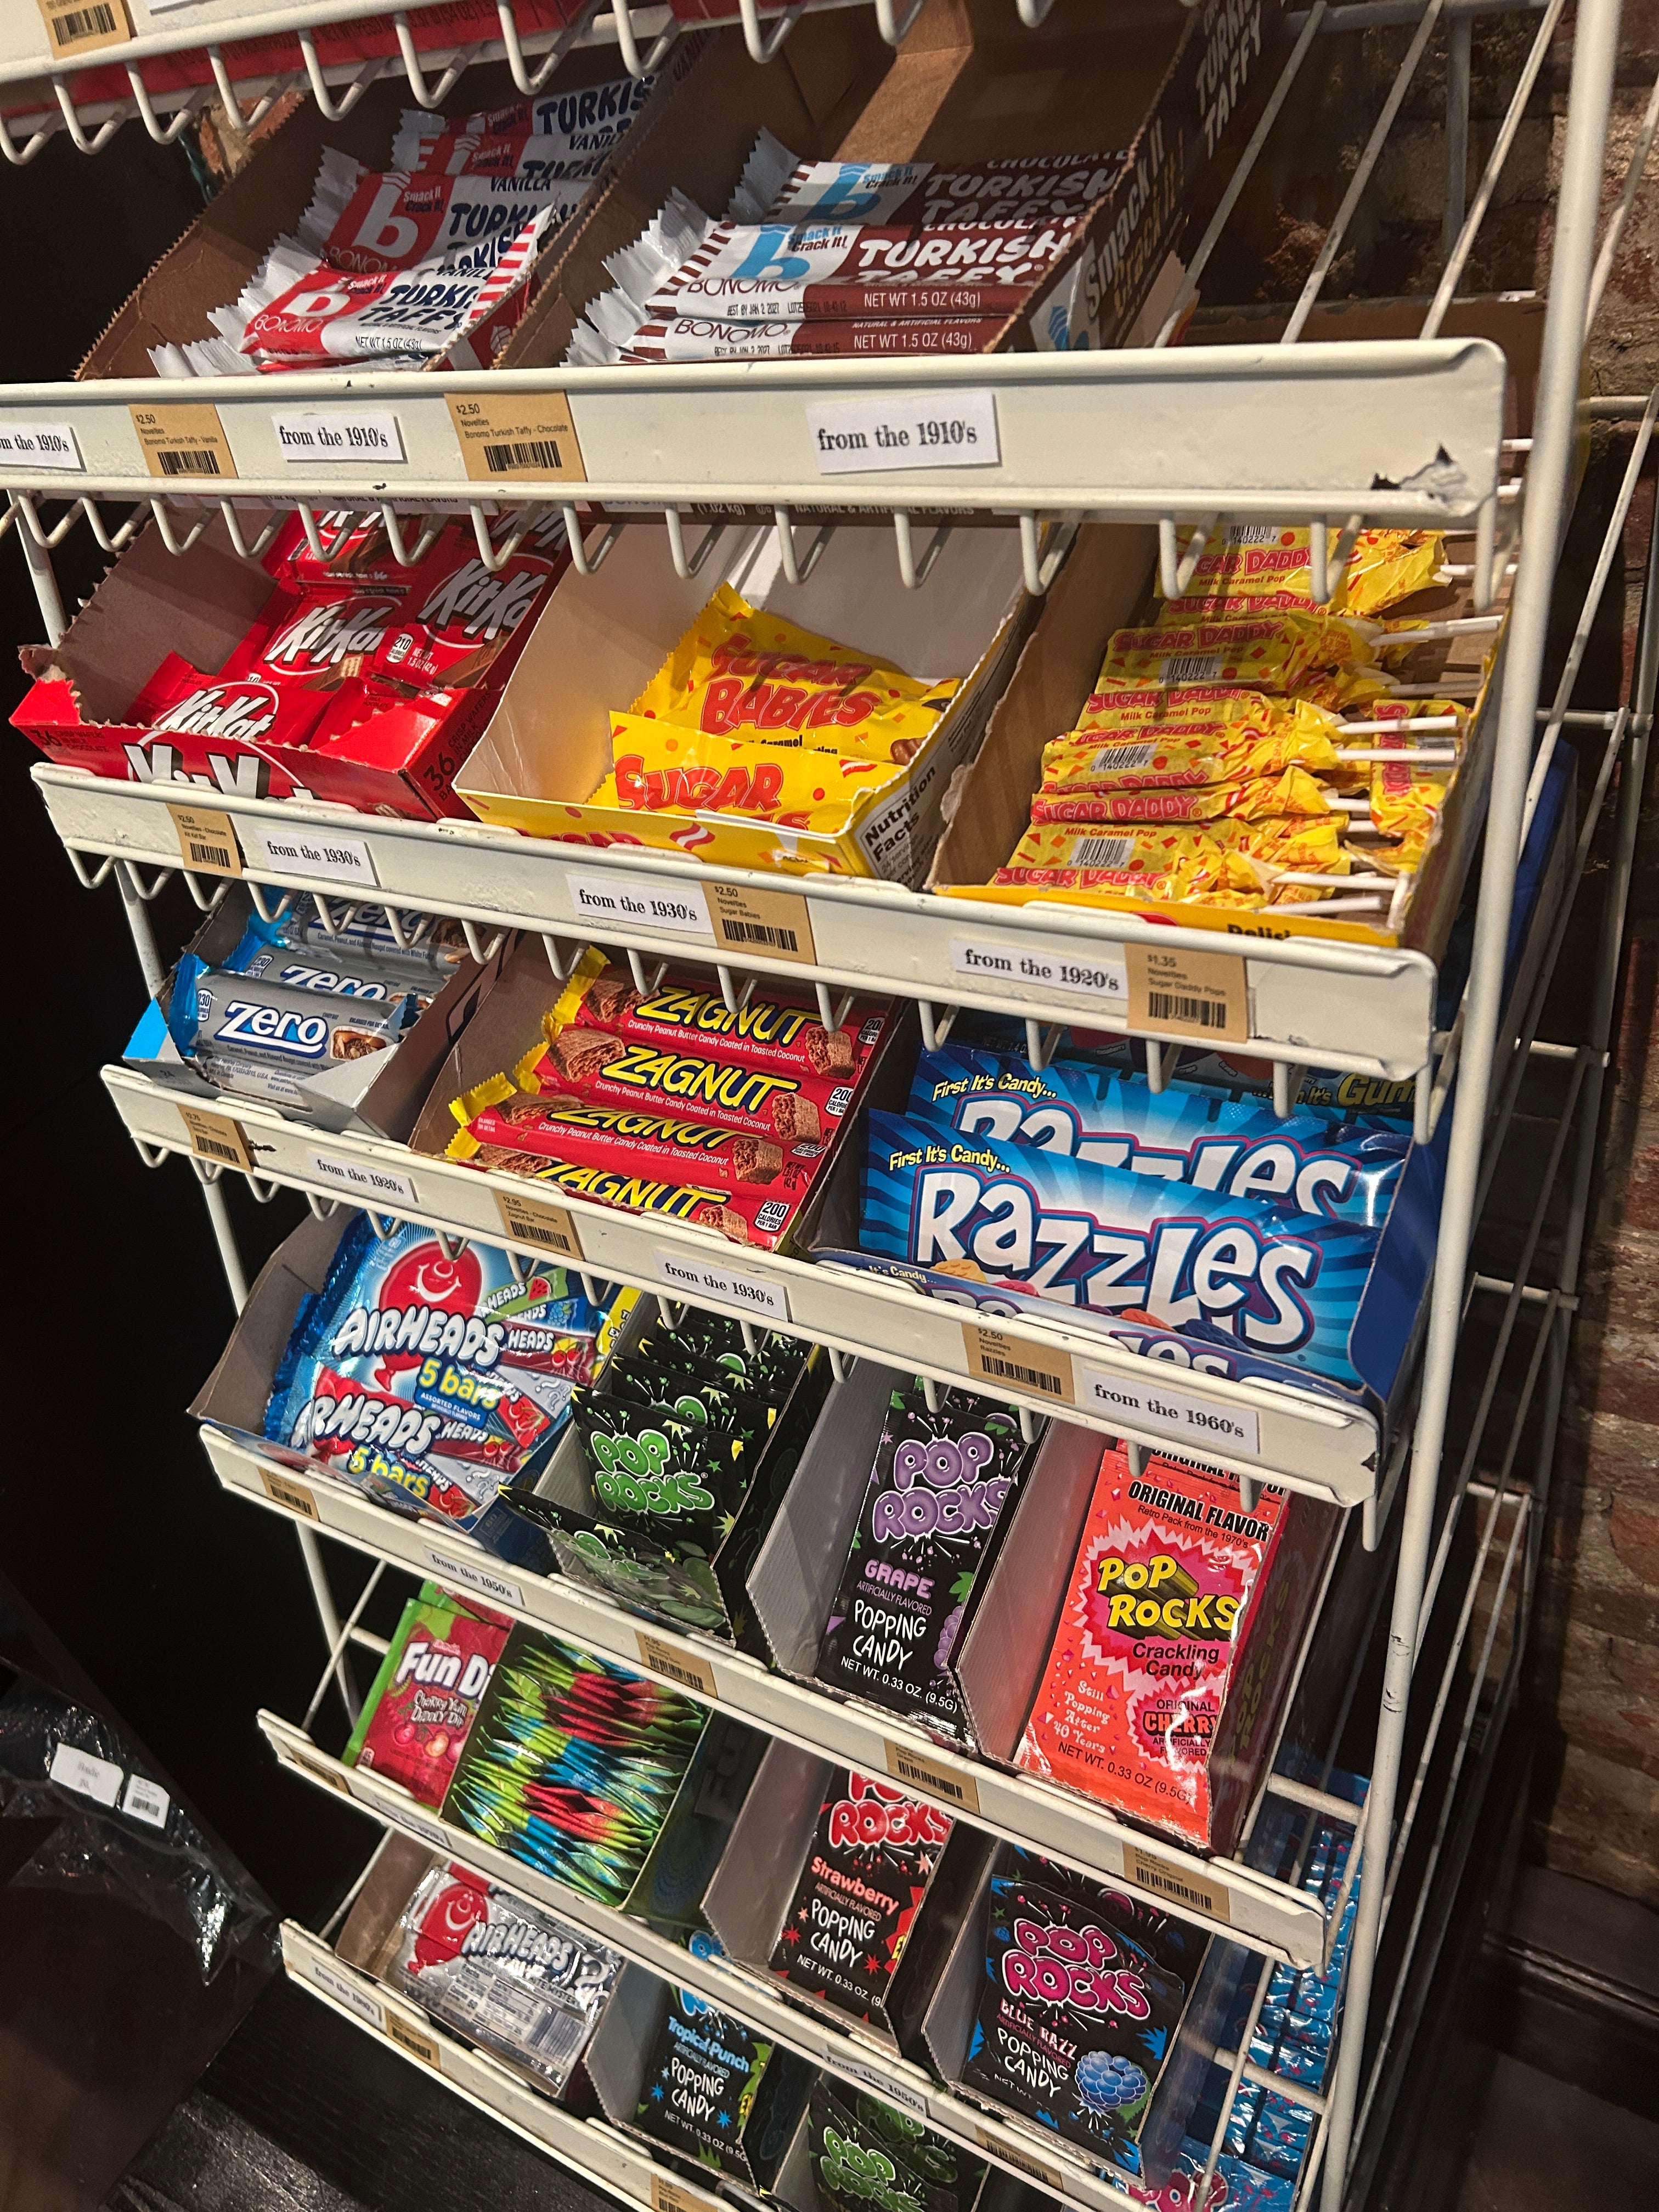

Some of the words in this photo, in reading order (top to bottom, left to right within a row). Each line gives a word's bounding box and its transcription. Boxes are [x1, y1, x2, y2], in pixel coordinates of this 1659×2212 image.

[926, 168, 1116, 200] TURKISH
[788, 227, 828, 243] Smack
[831, 225, 842, 236] It
[792, 239, 828, 251] Crack
[859, 229, 1071, 267] TURKISH
[687, 278, 794, 296] BONOMO
[255, 314, 322, 334] BONOMO
[675, 319, 788, 342] BONOMO
[854, 335, 876, 348] NET
[879, 335, 898, 348] WT
[902, 334, 918, 347] 1.5
[922, 334, 938, 347] OZ
[941, 334, 972, 349] (43g)
[136, 414, 155, 424] $2.50
[456, 404, 480, 414] $2.50
[15, 435, 35, 450] the
[36, 435, 69, 452] 1910's
[280, 426, 315, 445] from
[317, 427, 342, 445] the
[345, 427, 388, 447] 1910's
[516, 427, 532, 435] Taffy
[538, 425, 567, 433] Chocolate
[819, 428, 867, 450] from
[876, 425, 910, 448] the
[918, 422, 977, 445] 1910's
[394, 636, 411, 650] 210
[713, 633, 872, 685] SUGAR
[701, 678, 882, 736] BABIES
[614, 755, 783, 811] SUGAR
[865, 768, 936, 845] Nutrition
[1032, 799, 1107, 825] SUGAR
[1110, 794, 1199, 819] DADDY
[874, 811, 919, 862] Facts
[1064, 827, 1087, 836] Milk
[1089, 828, 1134, 837] Caramel
[1136, 829, 1156, 838] Pop
[267, 841, 298, 857] from
[301, 845, 321, 860] the
[323, 848, 360, 866] 1930's
[579, 889, 616, 908] from
[620, 893, 645, 913] the
[649, 900, 697, 921] 1930's
[714, 886, 738, 898] $2.50
[718, 898, 747, 908] Novelties
[719, 907, 737, 916] Sugar
[739, 910, 760, 919] Babies
[966, 949, 1012, 971] from
[1020, 958, 1052, 979] the
[1059, 965, 1119, 991] 1920's
[1148, 978, 1172, 989] Sugar
[602, 1045, 799, 1113] ZAGNUT
[596, 1080, 621, 1095] Crunchy
[622, 1086, 644, 1099] Peanut
[645, 1092, 664, 1104] Butter
[665, 1097, 685, 1111] Candy
[686, 1103, 708, 1115] Coated
[710, 1107, 715, 1117] in
[717, 1110, 743, 1124] Toasted
[743, 1117, 770, 1131] Coconut
[889, 1149, 923, 1171] First
[926, 1146, 947, 1164] It's
[951, 1144, 1011, 1172] Candy...
[318, 1159, 344, 1177] from
[349, 1168, 367, 1183] the
[370, 1174, 404, 1194] 1920's
[503, 1197, 521, 1206] $2.95
[762, 1201, 787, 1218] 200
[758, 1214, 781, 1225] CALORIES
[665, 1262, 699, 1283] from
[703, 1274, 727, 1291] the
[732, 1282, 774, 1306] 1930's
[331, 1306, 504, 1366] AIRHEADS
[978, 1328, 1002, 1341] $2.50
[979, 1338, 1011, 1351] Novelties
[420, 1361, 441, 1387] 5
[440, 1367, 500, 1408] bars
[421, 1392, 453, 1409] ASSORTED
[453, 1404, 481, 1420] FLAVORS
[1094, 1384, 1140, 1408] from
[1147, 1398, 1178, 1418] the
[1186, 1409, 1244, 1437] 1960's
[590, 1429, 670, 1477] POP
[894, 1432, 994, 1491] POP
[595, 1470, 714, 1514] ROCKS
[1128, 1481, 1205, 1521] ORIGINAL
[1205, 1497, 1269, 1543] FLAVOR
[1138, 1504, 1160, 1521] Retro
[1161, 1509, 1182, 1527] Pack
[1183, 1516, 1201, 1532] from
[1203, 1522, 1218, 1536] the
[1221, 1527, 1249, 1548] 1970's
[432, 1554, 457, 1572] from
[460, 1569, 478, 1581] the
[481, 1576, 512, 1598] 1950's
[865, 1559, 934, 1599] GRAPE
[856, 1581, 896, 1603] ARTIFICIALLY
[896, 1595, 932, 1616] FLAVORED
[854, 1599, 927, 1640] POPPING
[394, 1641, 462, 1690] Fun
[853, 1635, 913, 1671] CANDY
[1132, 1643, 1220, 1663] Crackling
[1146, 1661, 1204, 1678] Candy
[841, 1656, 861, 1675] NET
[862, 1663, 880, 1681] WT.
[882, 1672, 904, 1690] 0.33
[905, 1681, 923, 1700] OZ.
[925, 1690, 957, 1714] (9.5G)
[1079, 1680, 1104, 1701] Still
[1065, 1691, 1109, 1724] Popping
[1065, 1709, 1100, 1733] After
[1053, 1722, 1069, 1737] 40
[1075, 1729, 1105, 1753] Years
[811, 1855, 900, 1916] Strawberry
[811, 1898, 876, 1940] POPPING
[810, 1932, 863, 1968] CANDY
[1013, 1917, 1117, 1970] POP
[1002, 1948, 1151, 2021] ROCKS
[668, 2016, 710, 2051] Tropical
[710, 2042, 748, 2072] Punch
[1001, 1998, 1034, 2031] BLUE
[1039, 2027, 1077, 2060] RAZZ
[997, 2027, 1069, 2080] POPPING
[672, 2057, 724, 2097] POPPING
[1005, 2056, 1060, 2097] CANDY
[672, 2089, 715, 2121] CANDY
